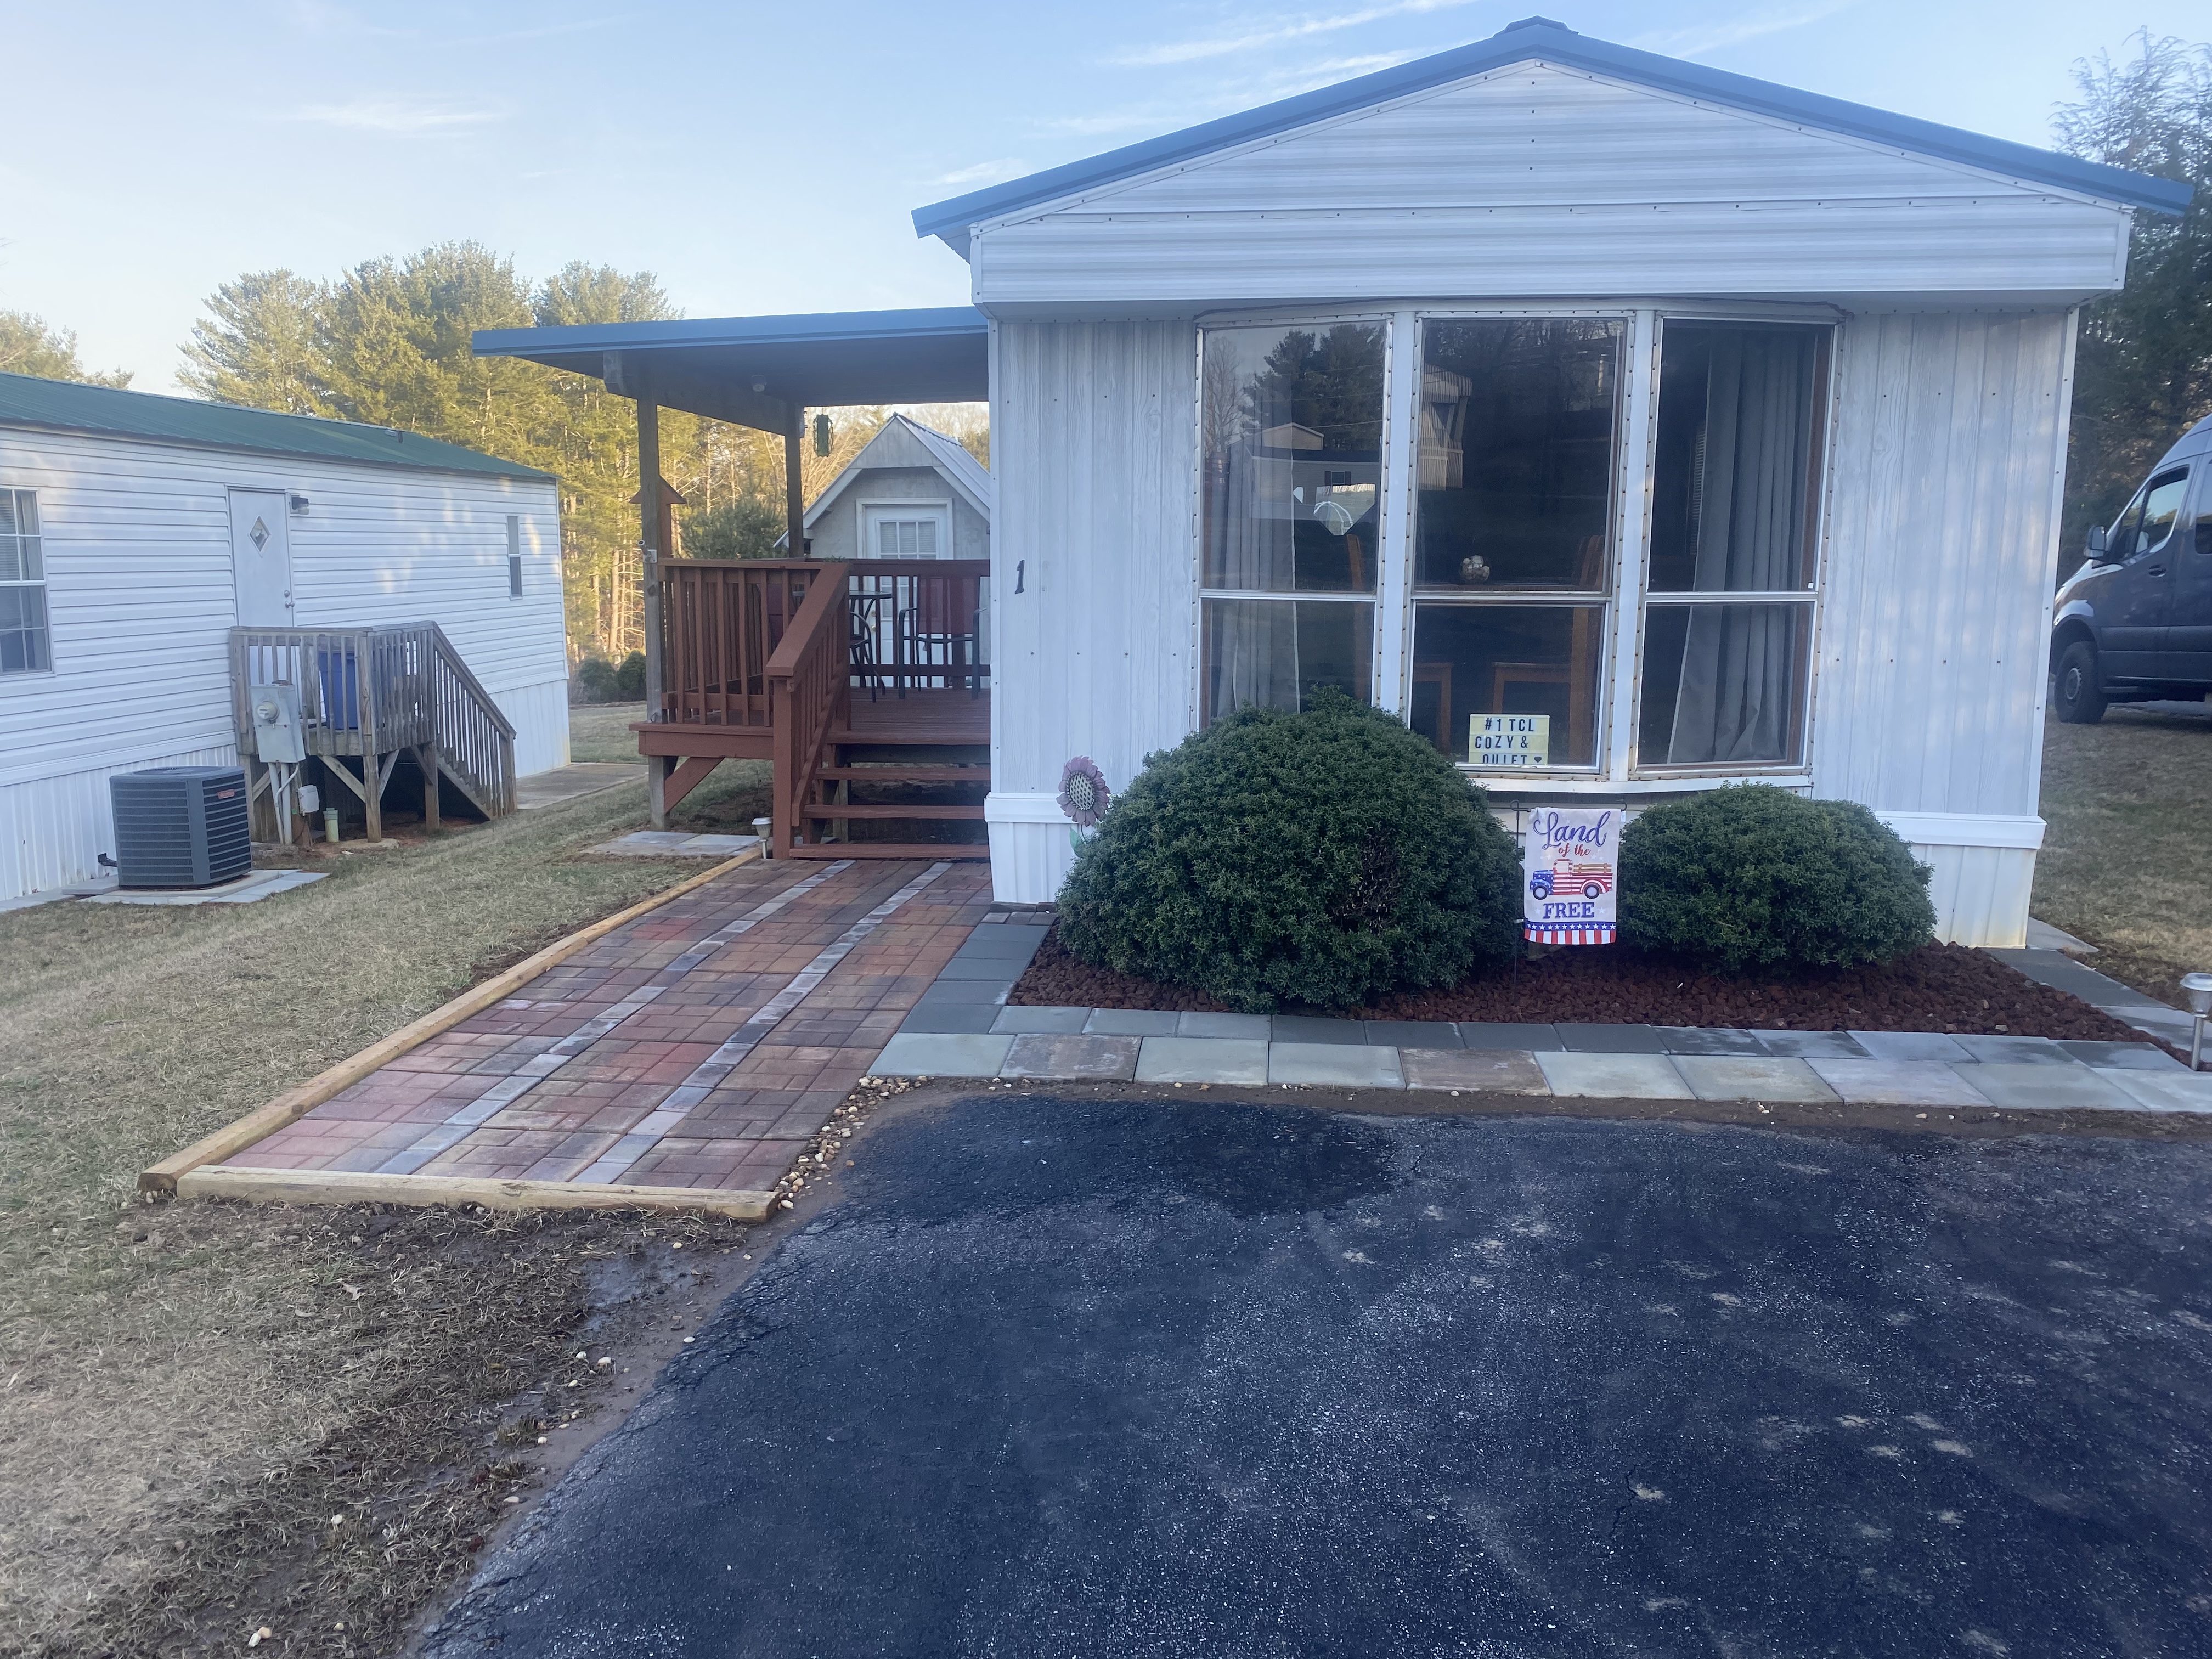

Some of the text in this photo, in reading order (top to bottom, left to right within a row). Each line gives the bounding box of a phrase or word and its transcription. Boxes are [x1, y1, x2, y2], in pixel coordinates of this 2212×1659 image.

[1014, 560, 1025, 594] 1
[1509, 719, 1534, 732] TCL
[1475, 736, 1528, 749] COZY &
[1532, 811, 1611, 850] Land
[1558, 843, 1591, 857] of the
[1543, 902, 1595, 919] FREE
